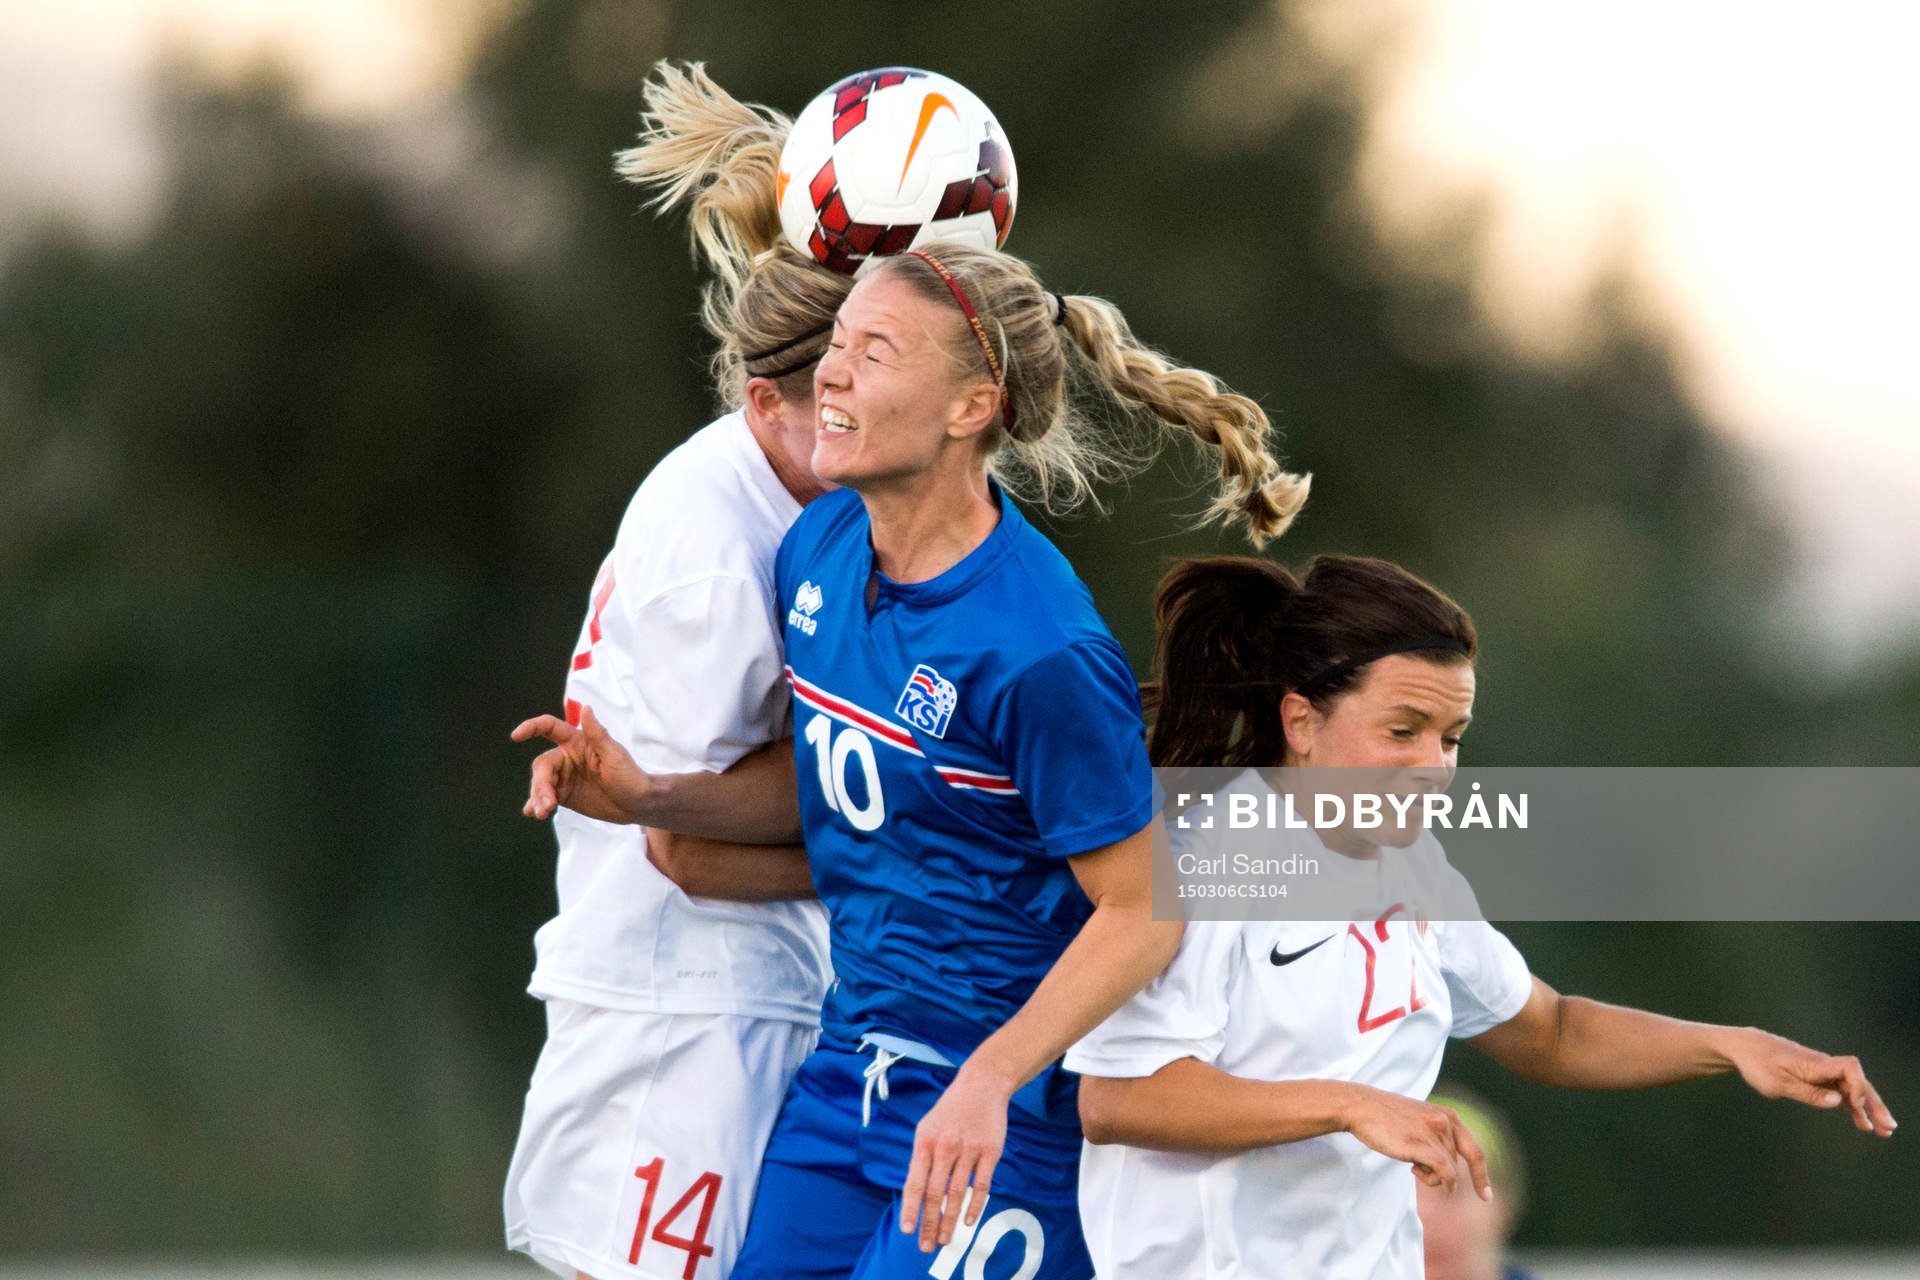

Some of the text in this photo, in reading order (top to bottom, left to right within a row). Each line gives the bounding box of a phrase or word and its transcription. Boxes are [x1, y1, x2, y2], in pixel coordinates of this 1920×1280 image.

[969, 316, 999, 369] FLORIDA
[804, 713, 886, 832] 10
[629, 1157, 723, 1280] 14
